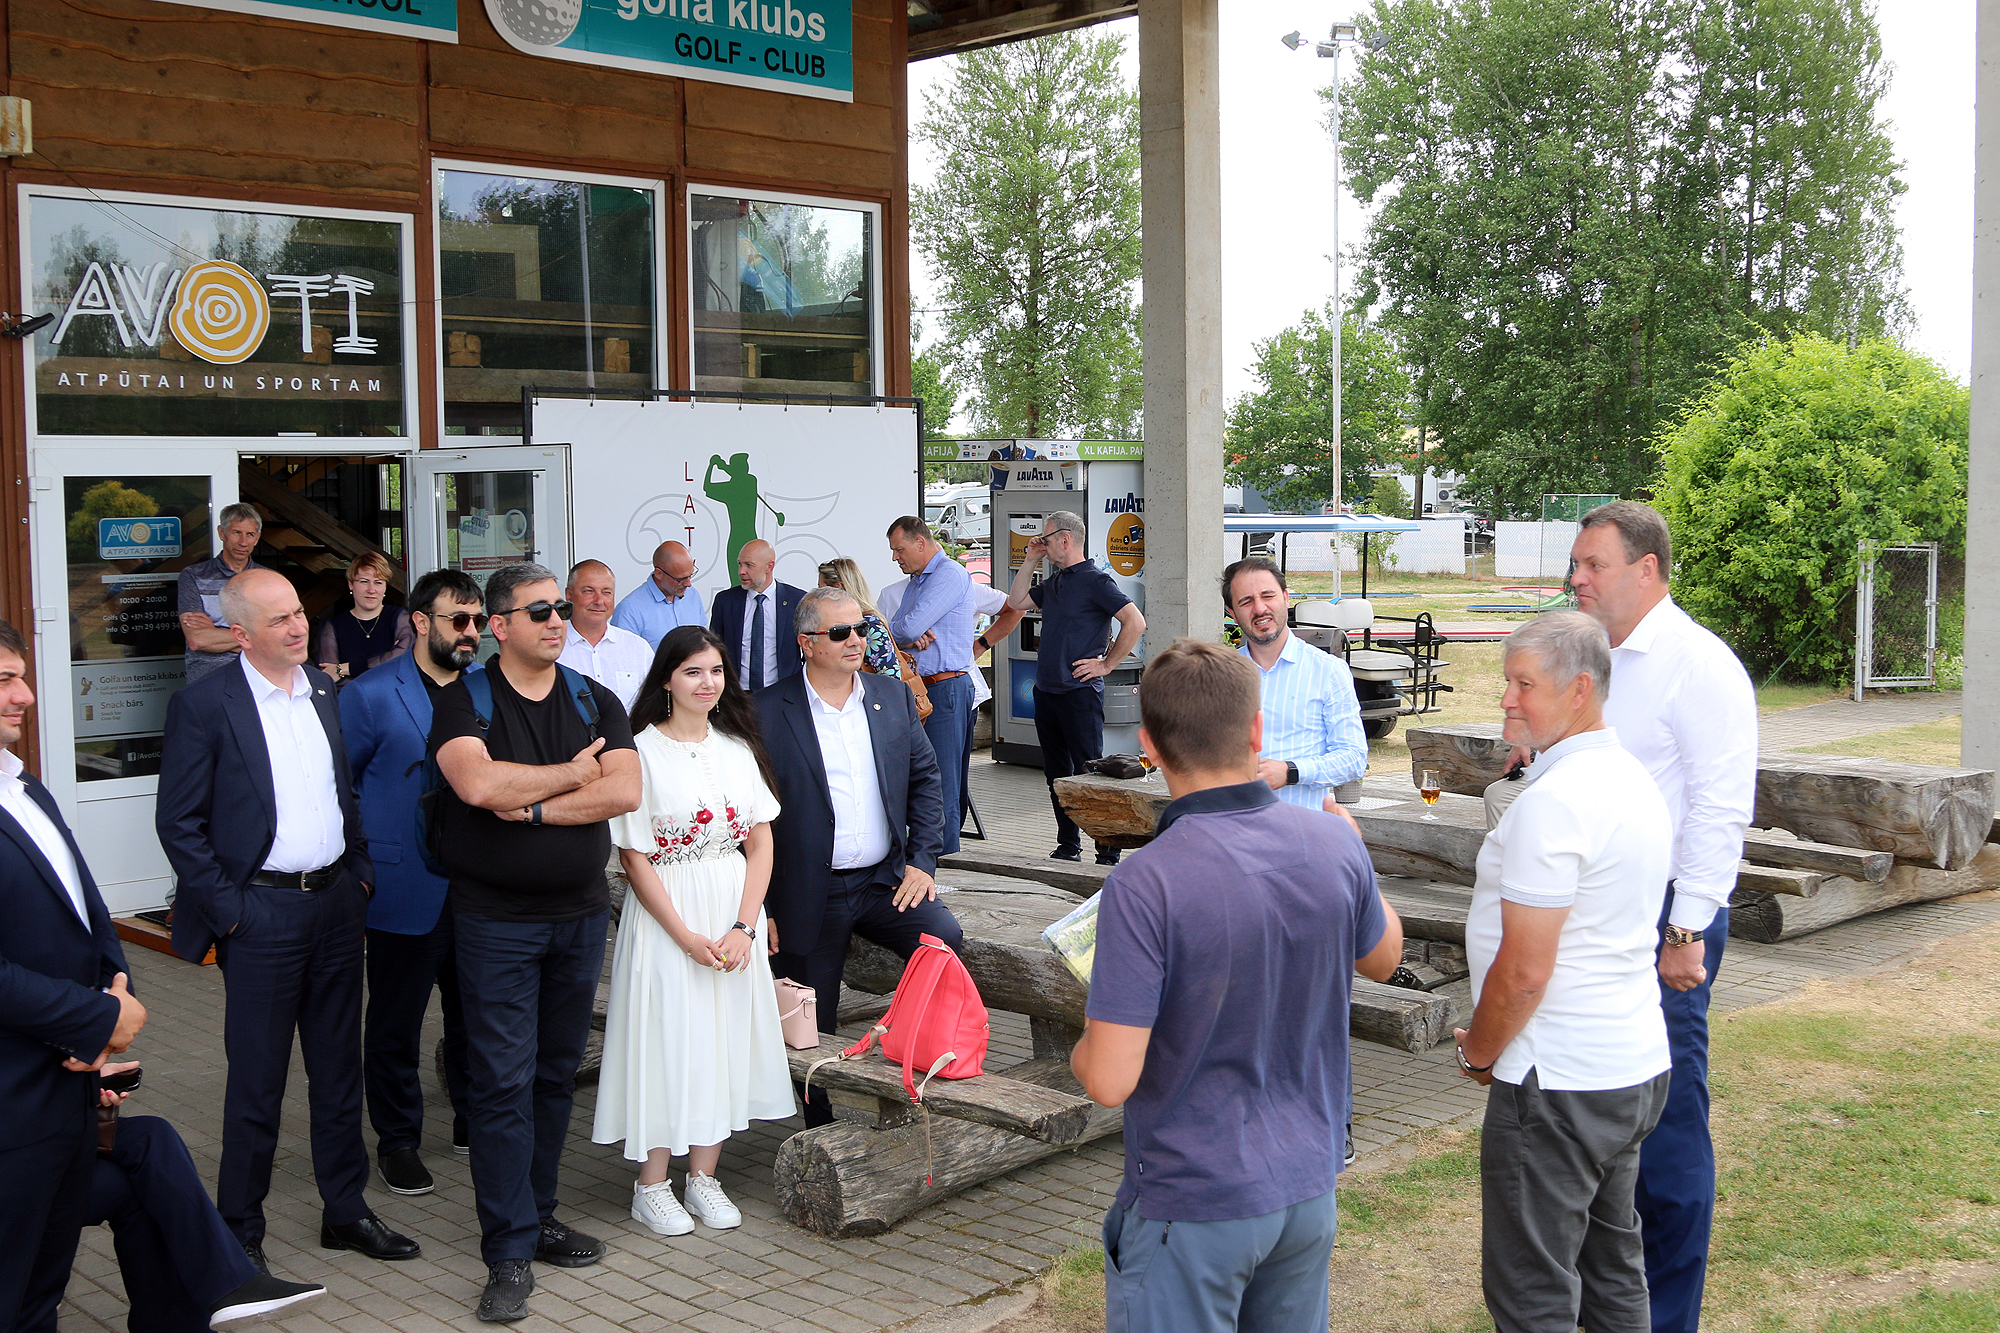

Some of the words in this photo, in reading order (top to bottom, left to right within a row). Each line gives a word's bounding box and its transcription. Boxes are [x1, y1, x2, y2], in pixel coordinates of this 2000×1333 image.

[675, 33, 741, 64] GOLF
[764, 47, 825, 78] CLUB
[51, 259, 379, 365] AVOTI
[58, 371, 185, 389] ATPŪTAI
[204, 376, 234, 389] UN
[256, 376, 381, 392] SPORTAM
[1084, 446, 1095, 455] XL
[1097, 446, 1128, 455] KAFIJA.
[1017, 467, 1054, 481] LAVAZZA
[106, 522, 175, 544] AVOTI
[107, 547, 145, 555] ATPŪTAS
[146, 595, 168, 603] 20:00
[155, 611, 169, 619] 770
[144, 623, 154, 631] 29
[100, 675, 121, 684] Golfa
[134, 673, 157, 682] tenisa
[158, 672, 178, 680] klubs
[101, 701, 124, 709] Snack
